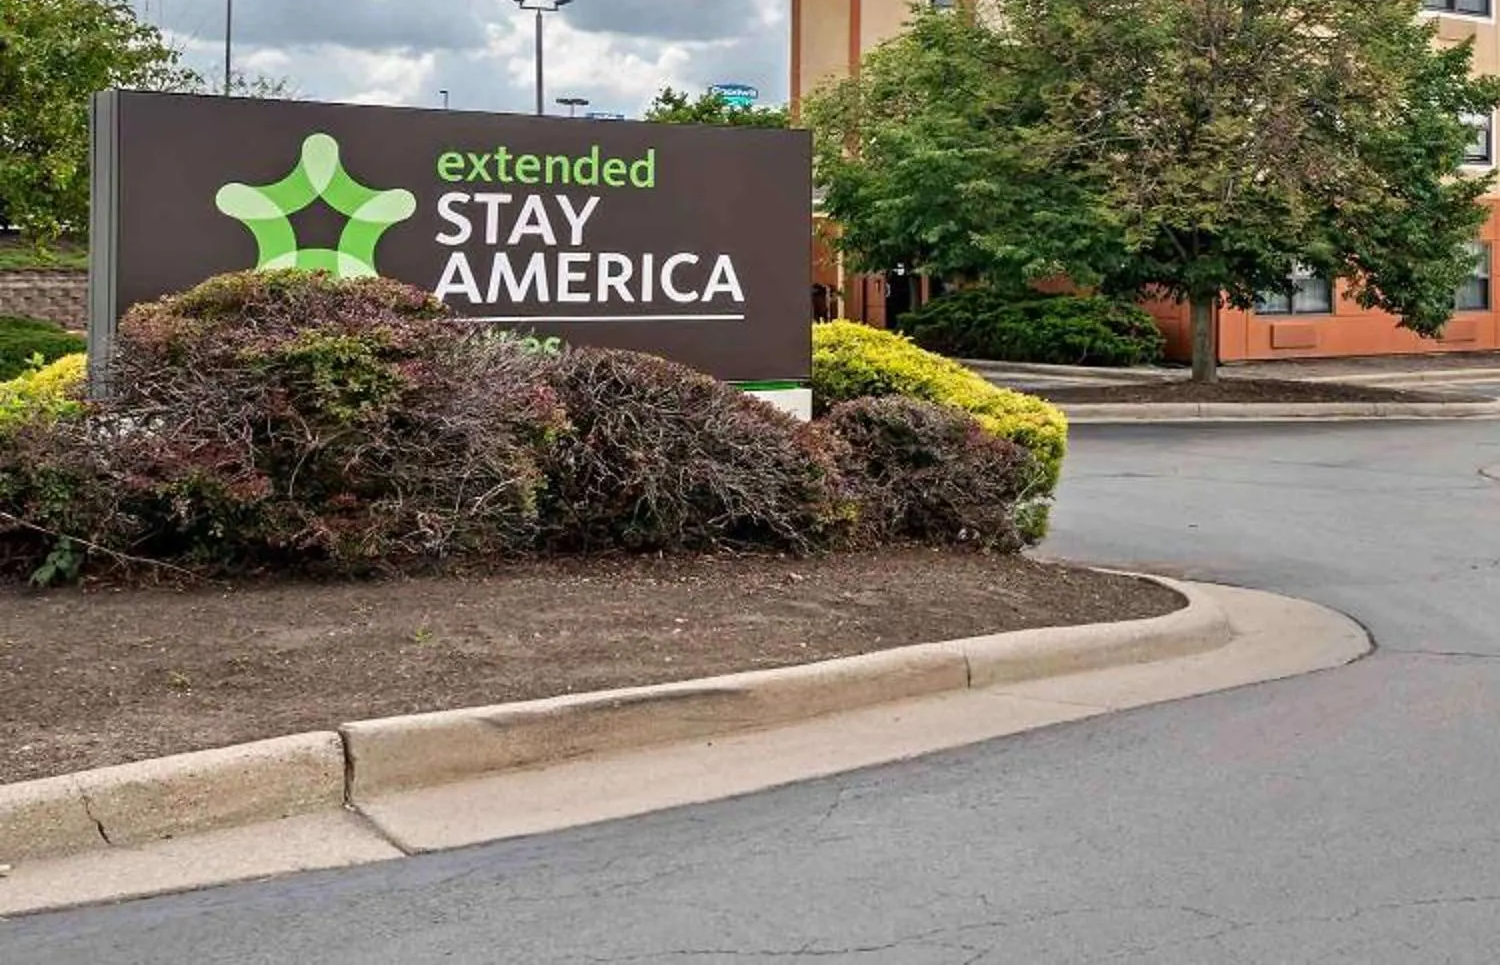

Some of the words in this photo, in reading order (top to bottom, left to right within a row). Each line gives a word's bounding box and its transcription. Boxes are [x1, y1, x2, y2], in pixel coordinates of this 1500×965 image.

[437, 145, 655, 187] extended
[435, 192, 600, 246] STAY
[434, 251, 745, 303] AMERICA
